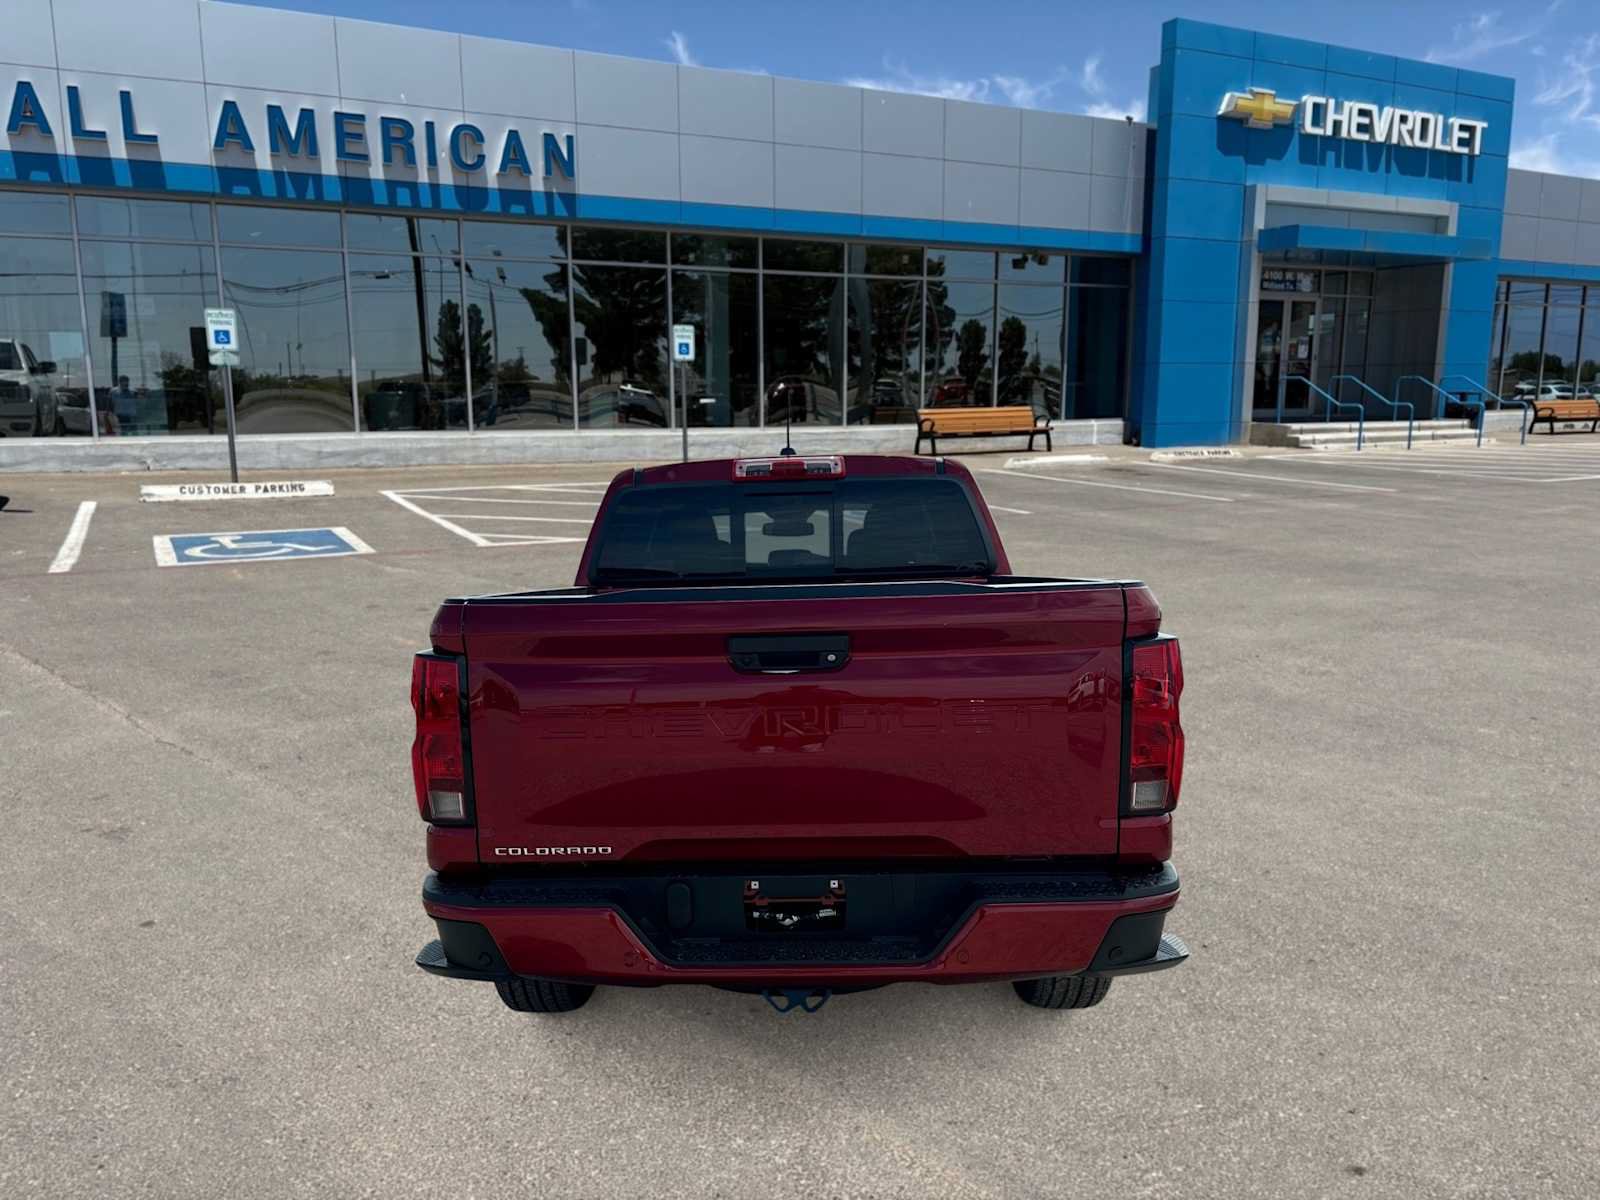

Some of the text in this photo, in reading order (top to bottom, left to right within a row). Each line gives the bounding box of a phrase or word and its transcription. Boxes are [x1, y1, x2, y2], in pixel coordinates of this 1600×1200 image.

[7, 80, 576, 179] ALL AMERICAN
[1300, 94, 1488, 156] CHEVROLET
[179, 483, 305, 495] CUSTOMER PARKING
[494, 846, 612, 856] COLORADO
